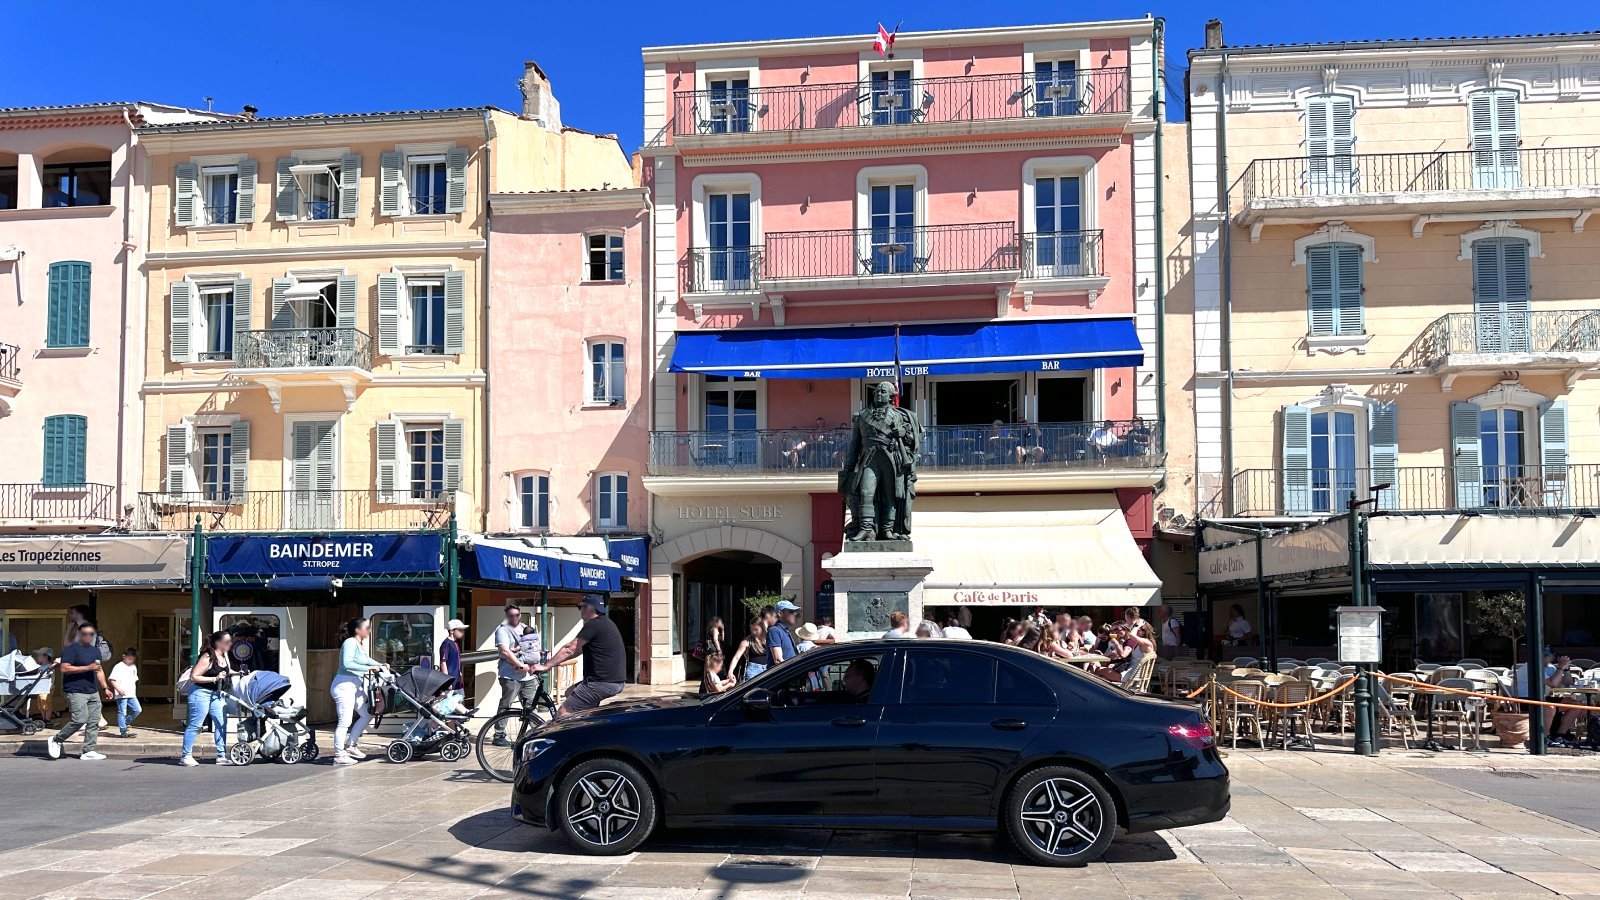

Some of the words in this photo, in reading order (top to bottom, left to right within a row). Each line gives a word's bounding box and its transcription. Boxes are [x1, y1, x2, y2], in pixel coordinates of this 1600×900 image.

[904, 366, 929, 376] SUBE
[1041, 360, 1060, 370] BAR
[740, 504, 783, 519] SUBE
[270, 542, 374, 558] BAINDEMER
[57, 564, 100, 572] SIGNATURE
[302, 560, 340, 568] ST.TROPEZ
[503, 554, 539, 572] BAINDEMER
[1228, 554, 1245, 573] Paris
[579, 566, 606, 580] BAINDEMER
[953, 591, 985, 603] Café
[988, 592, 1000, 601] de
[1002, 591, 1039, 603] Paris
